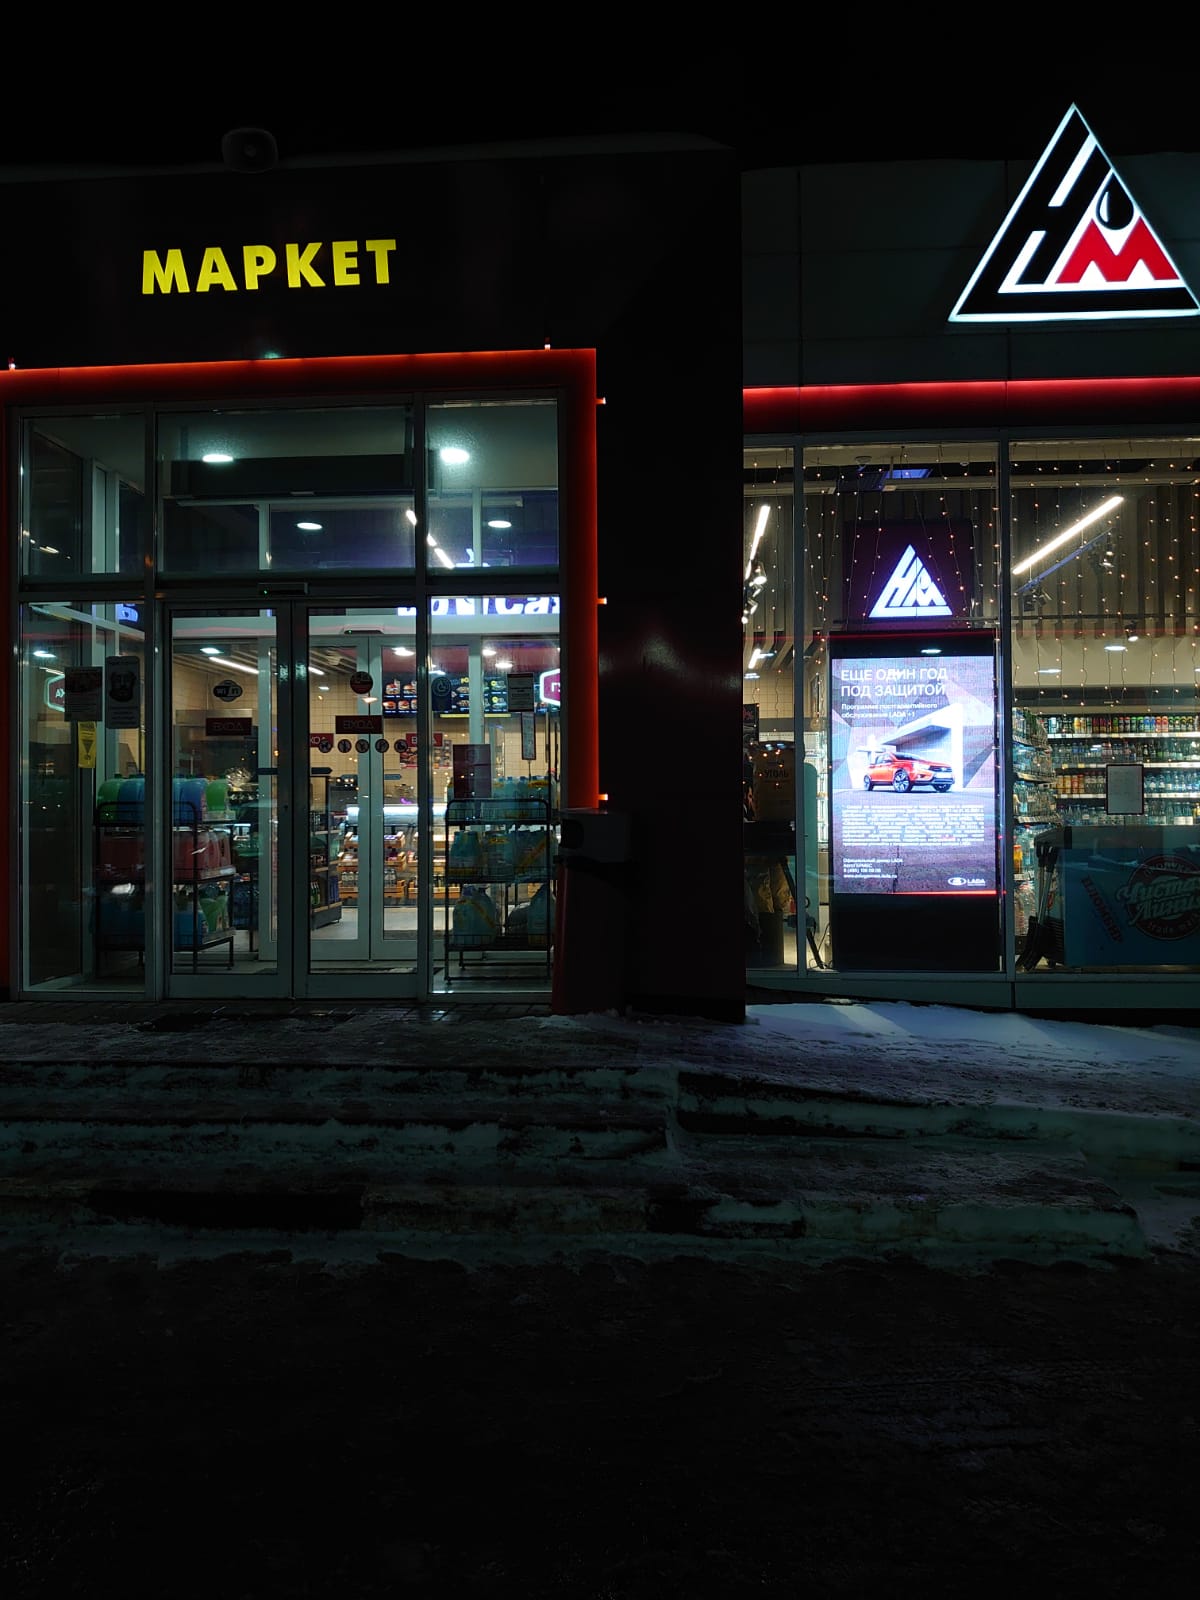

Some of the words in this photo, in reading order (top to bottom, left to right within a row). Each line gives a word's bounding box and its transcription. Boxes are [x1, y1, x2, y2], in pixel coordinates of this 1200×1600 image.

[142, 239, 397, 295] МАРКЕТ
[841, 669, 873, 683] ЕЩЕ
[876, 668, 916, 683] ОДИН
[919, 667, 948, 682] ГОД
[841, 685, 871, 698] ПОД
[874, 682, 946, 698] ЗАЩИТОЙ
[890, 710, 907, 718] LADA
[1116, 878, 1200, 904] Чиста
